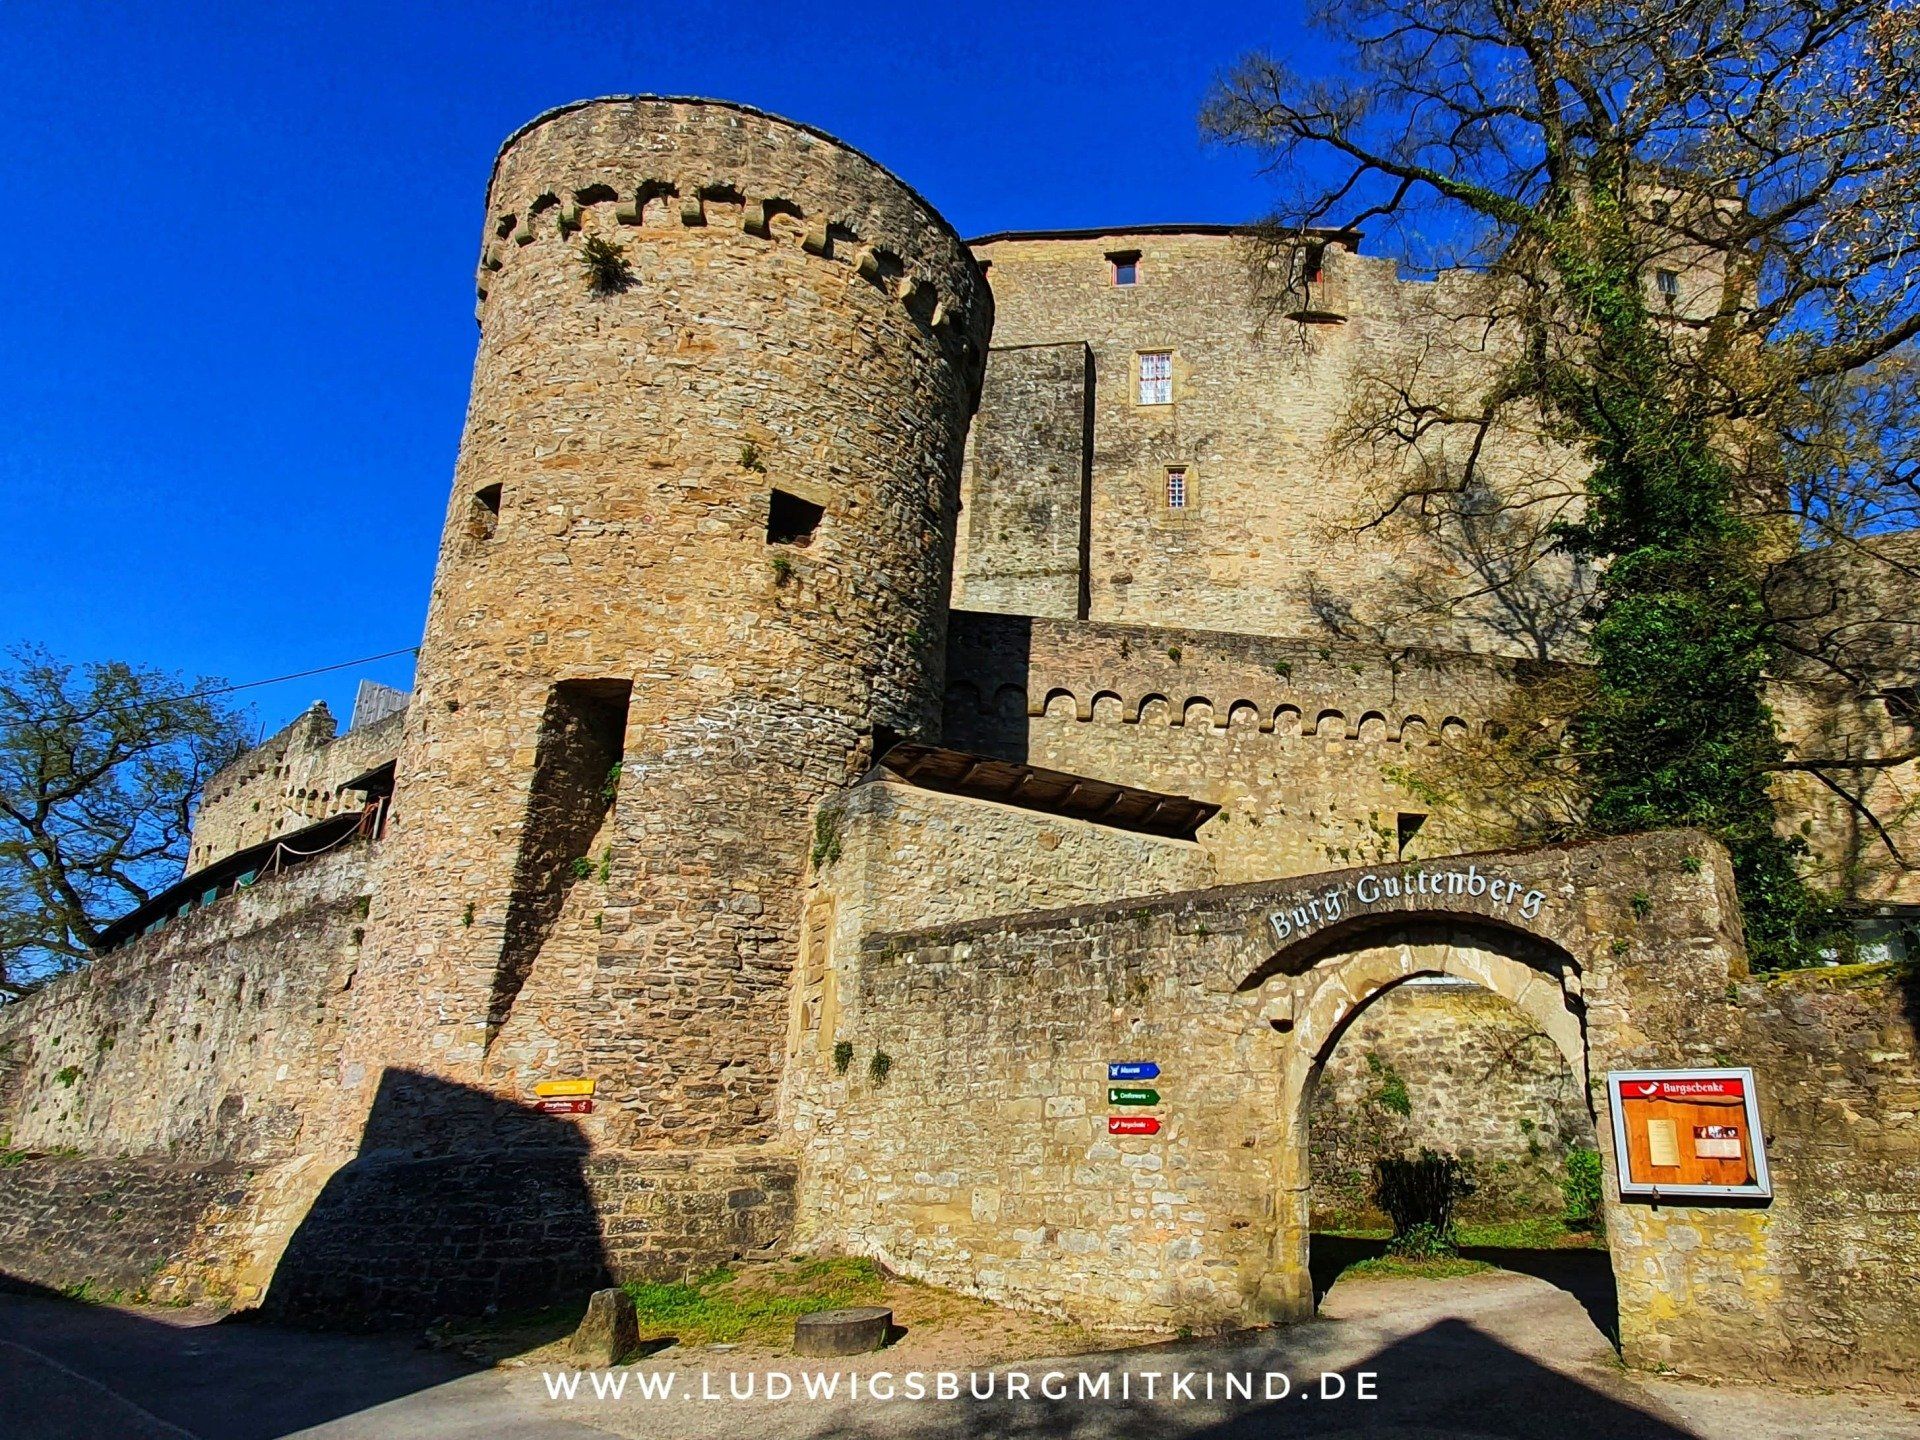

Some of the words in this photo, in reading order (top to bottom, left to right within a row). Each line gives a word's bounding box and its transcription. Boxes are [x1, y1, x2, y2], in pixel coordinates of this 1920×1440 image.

[1269, 890, 1342, 939] Burg
[1356, 865, 1547, 920] Guttenberg
[1663, 1081, 1725, 1095] Burgschenke
